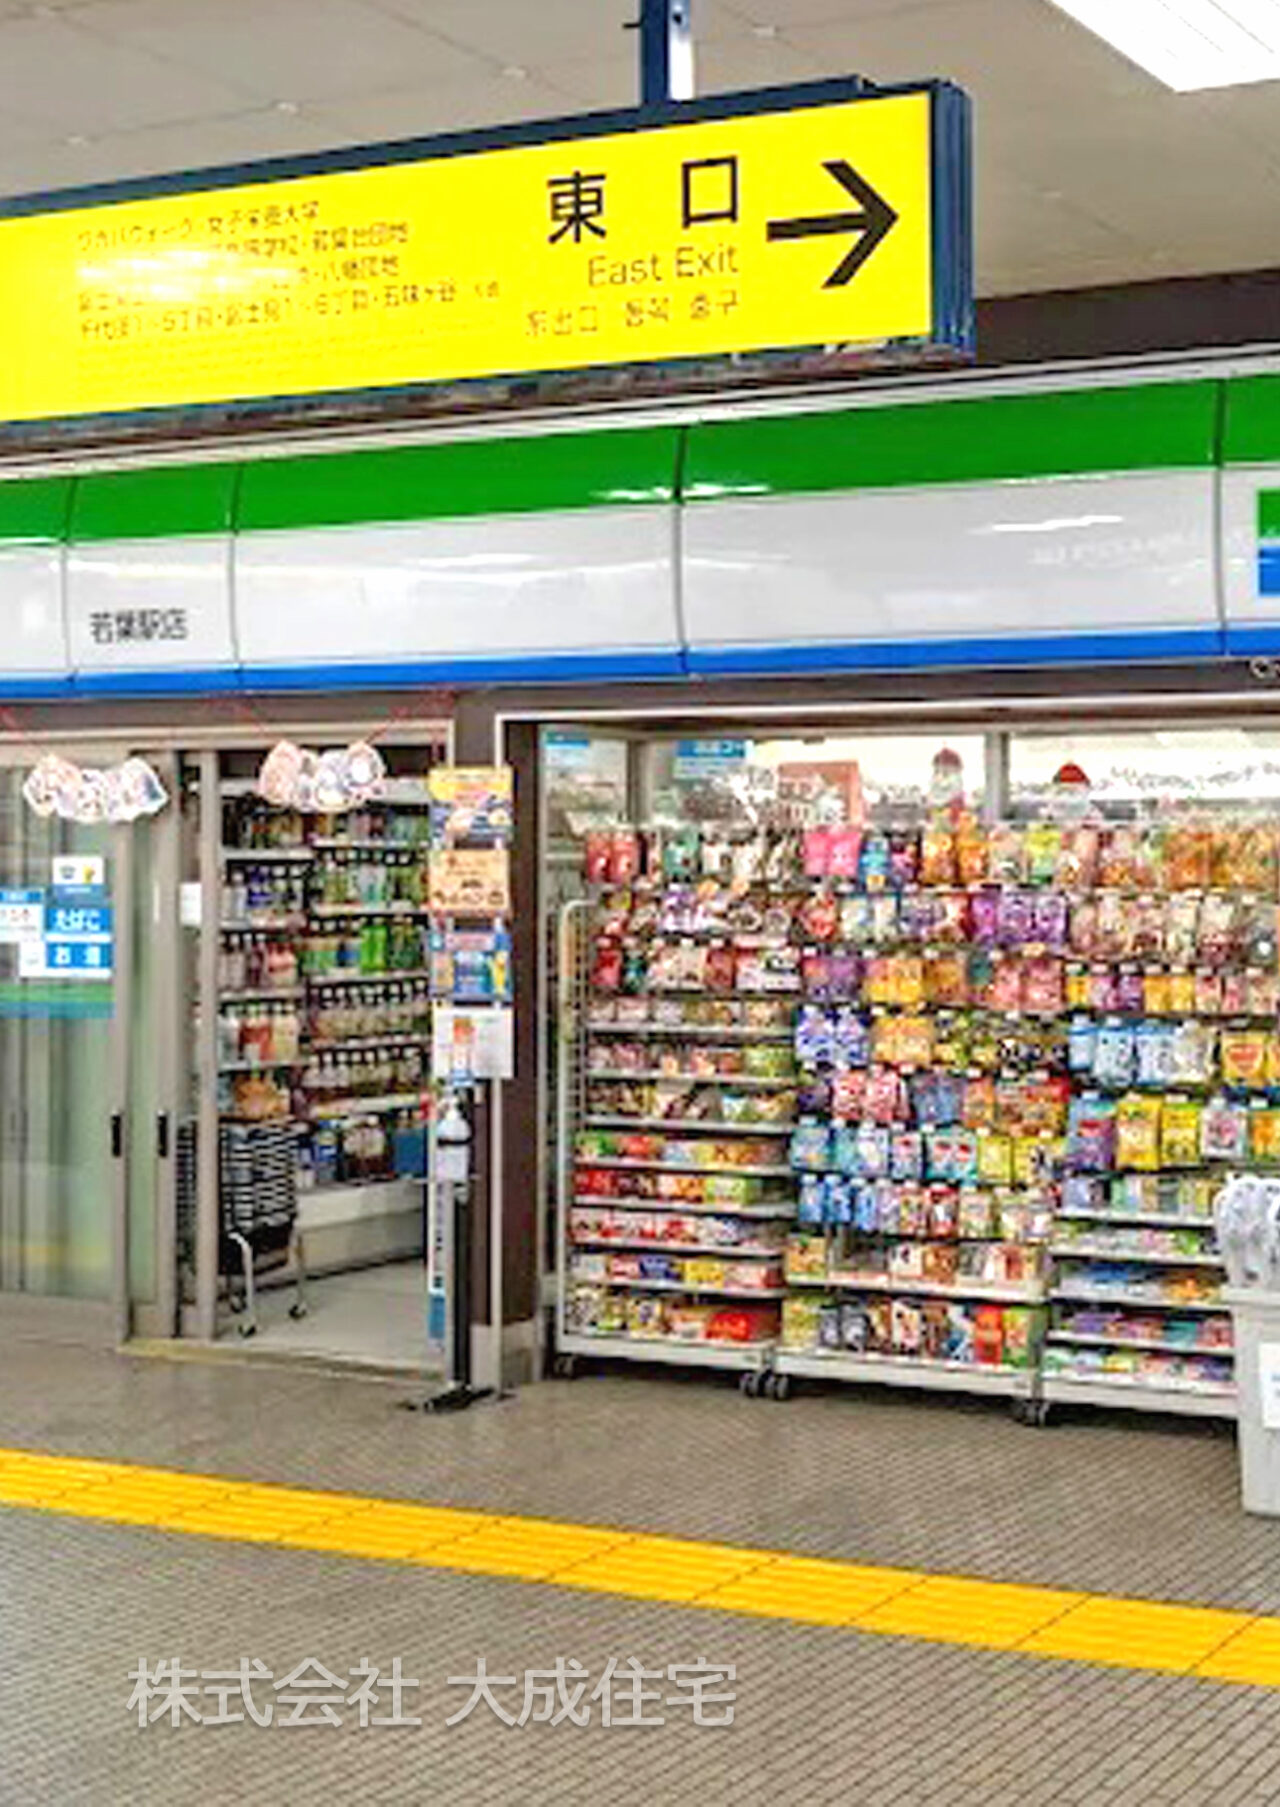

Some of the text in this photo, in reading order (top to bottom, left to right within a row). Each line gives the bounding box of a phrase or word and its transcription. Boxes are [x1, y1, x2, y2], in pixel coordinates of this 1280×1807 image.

[588, 243, 738, 288] East Exit
[90, 608, 188, 643] 若葉駅店
